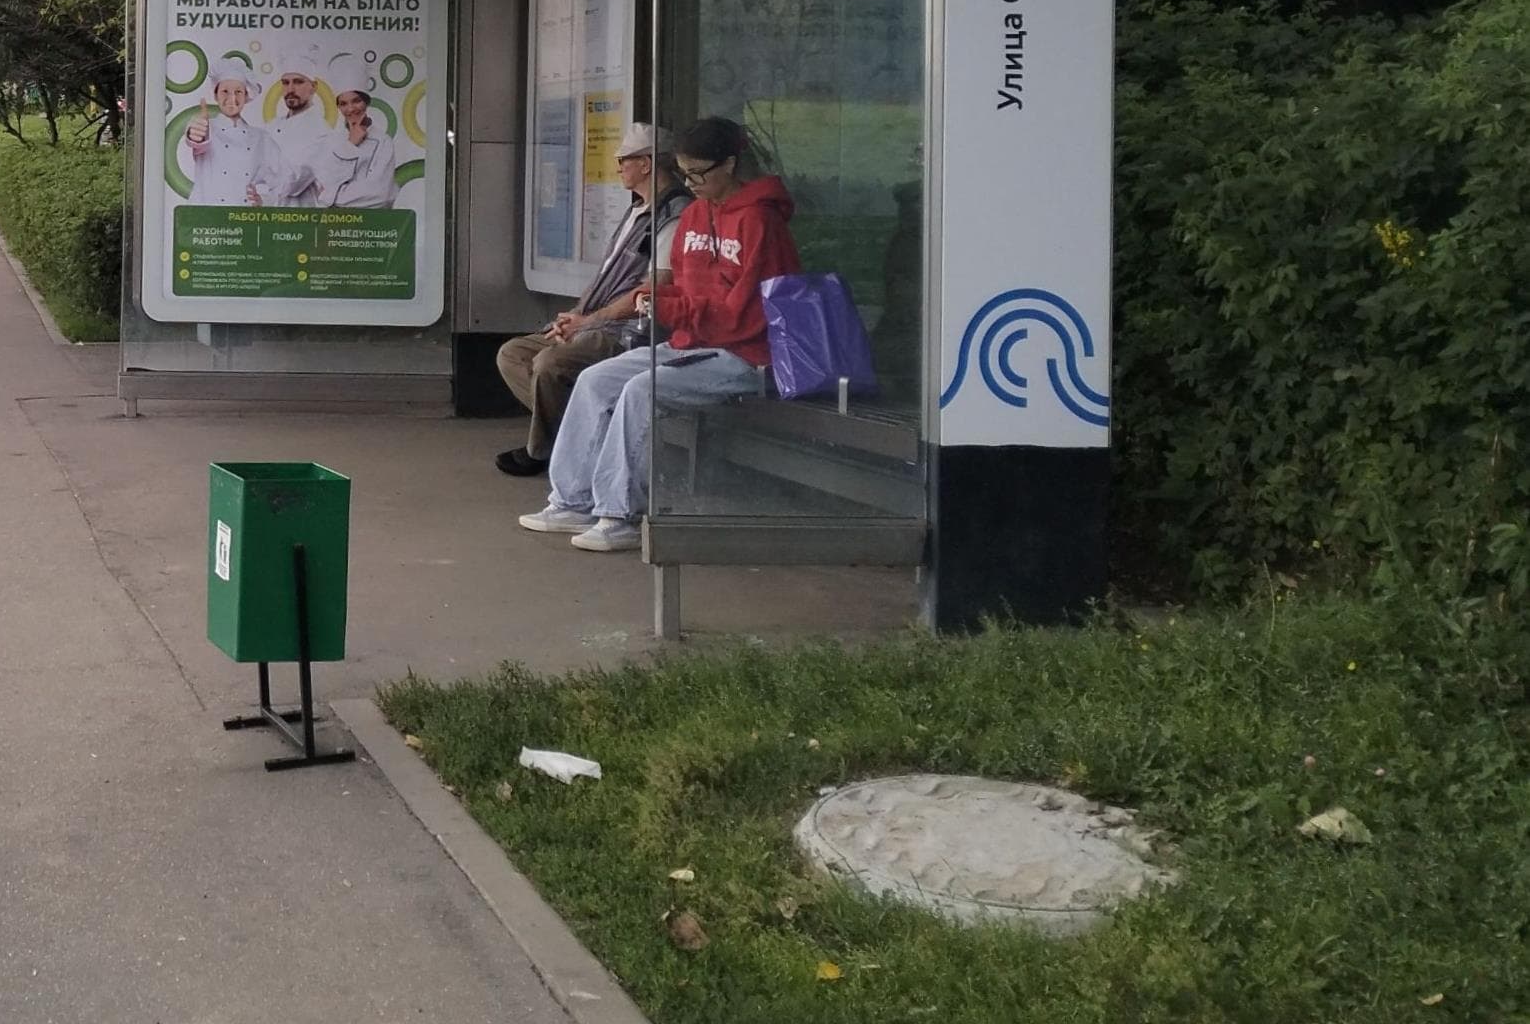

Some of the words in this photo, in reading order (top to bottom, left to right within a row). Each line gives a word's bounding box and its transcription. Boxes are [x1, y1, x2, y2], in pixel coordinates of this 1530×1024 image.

[176, 12, 285, 30] БУДУЩЕГО
[291, 14, 420, 32] ПОКОЛЕНИЯ!
[996, 10, 1026, 110] Улица
[228, 212, 269, 223] РАБОТА
[271, 213, 309, 224] РЯДОМ
[310, 214, 318, 224] С
[320, 214, 363, 225] ДОМОМ
[192, 226, 244, 237] КУХОННЫЙ
[272, 232, 304, 242] ПОВАР
[327, 228, 398, 240] ЗАВЕДУЮЩИЙ
[192, 237, 243, 247] РАБОТНИК
[327, 239, 398, 250] ПРОИЗВОДСТВОМ
